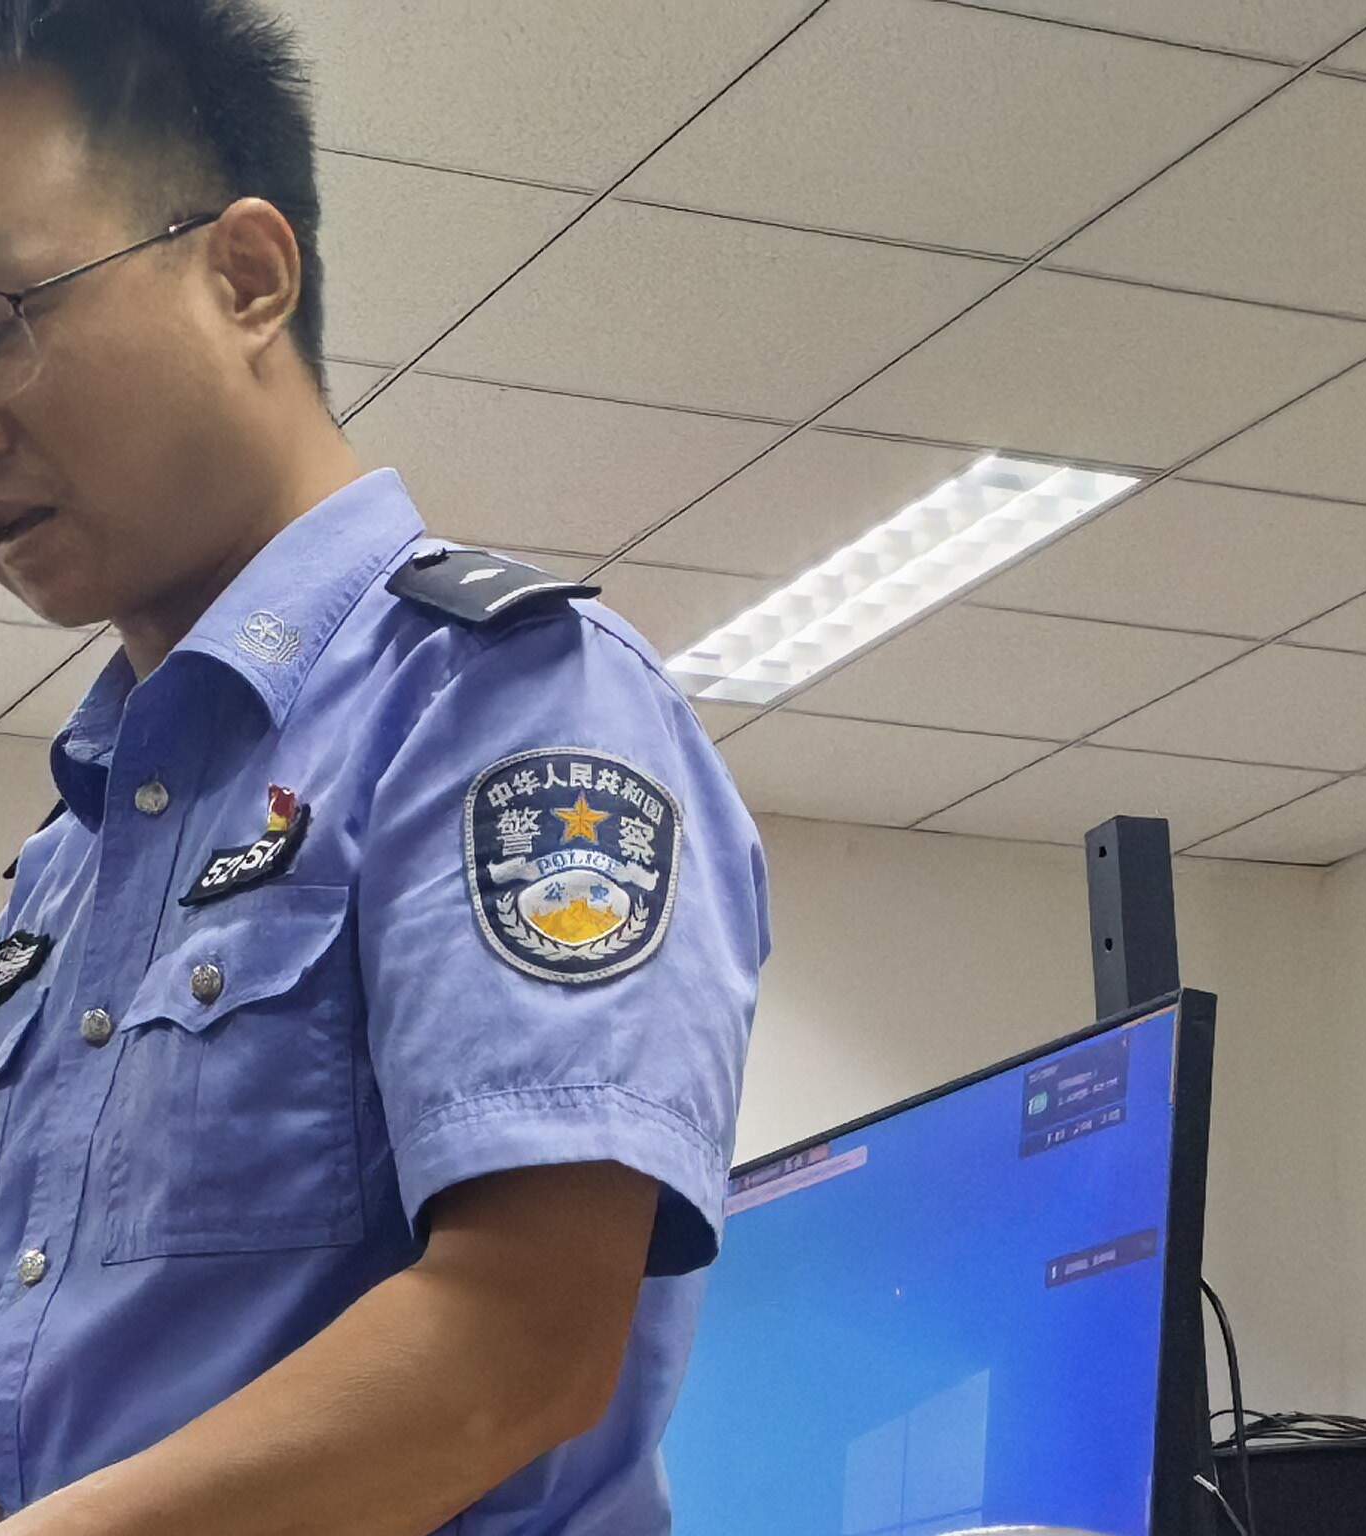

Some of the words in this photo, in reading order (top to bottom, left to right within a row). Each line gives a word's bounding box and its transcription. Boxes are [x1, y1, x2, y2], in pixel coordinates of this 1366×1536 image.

[487, 762, 663, 825] 中华人民共和国
